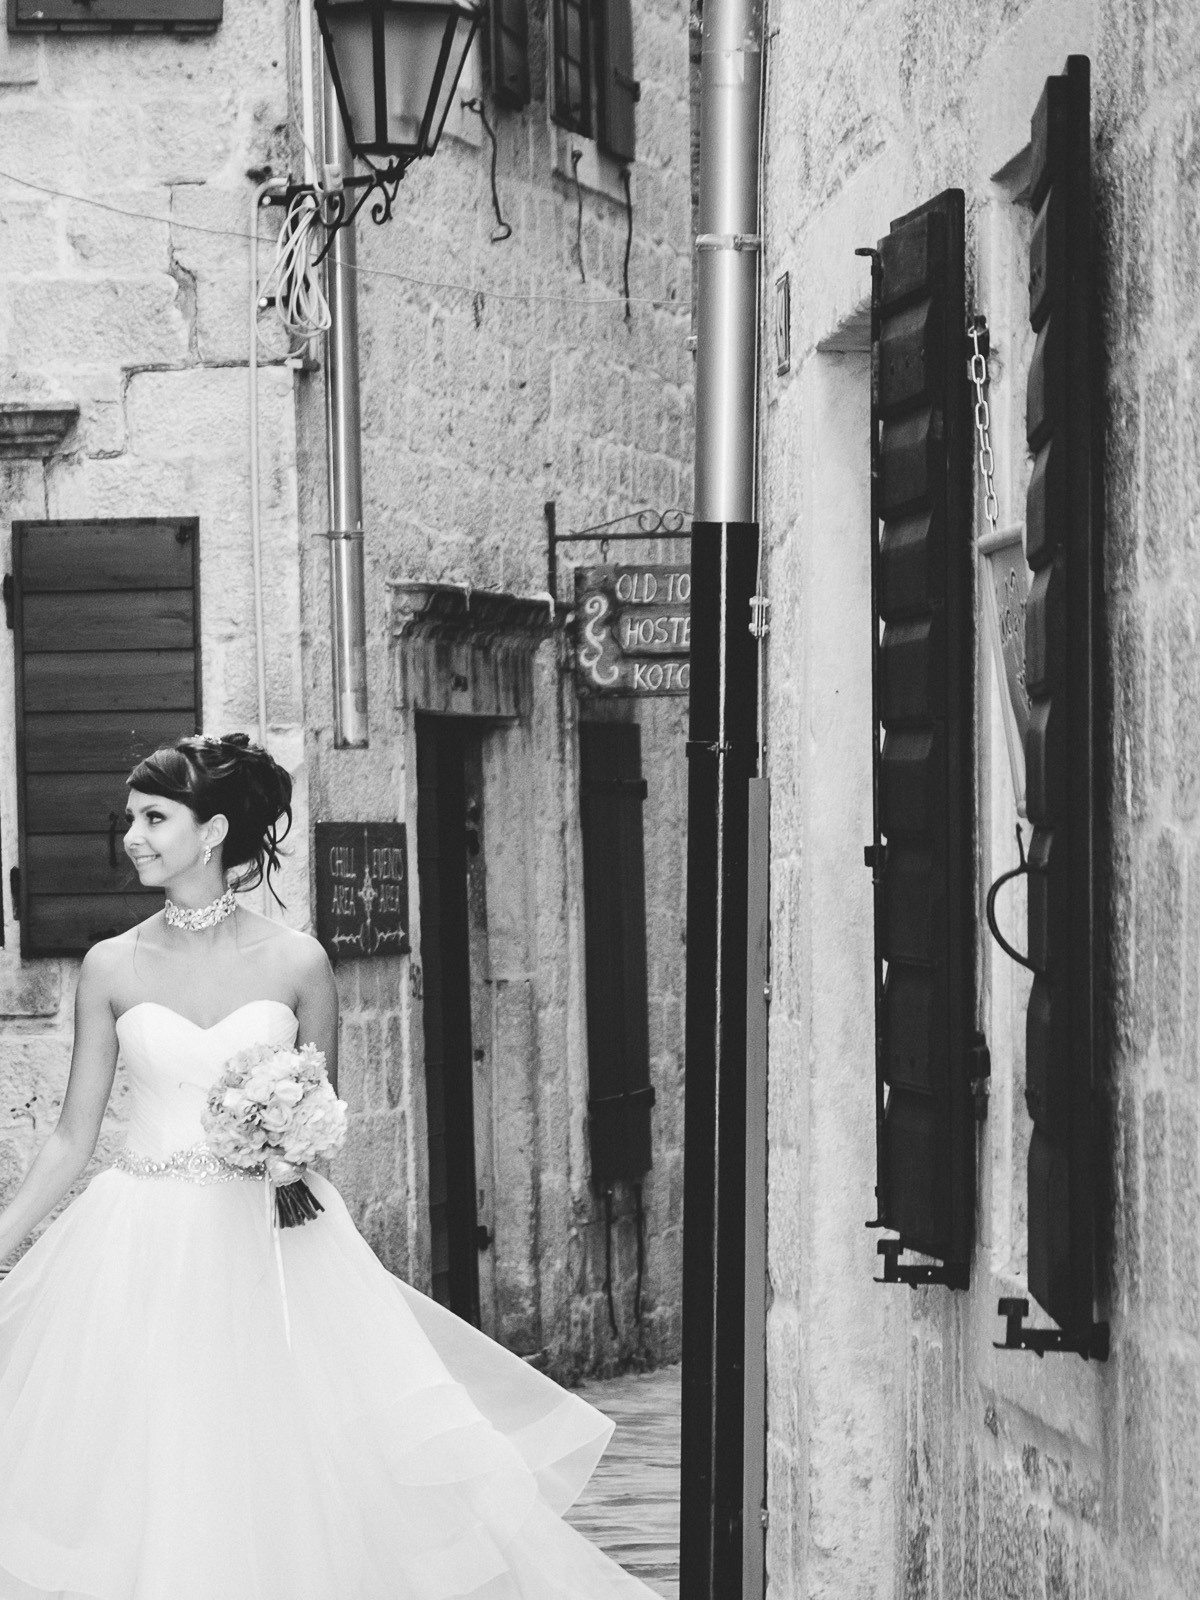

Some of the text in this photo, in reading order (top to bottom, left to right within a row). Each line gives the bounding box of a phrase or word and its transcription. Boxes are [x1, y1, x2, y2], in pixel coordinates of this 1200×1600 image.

[614, 572, 691, 604] OLD TO
[632, 663, 690, 690] KOTO
